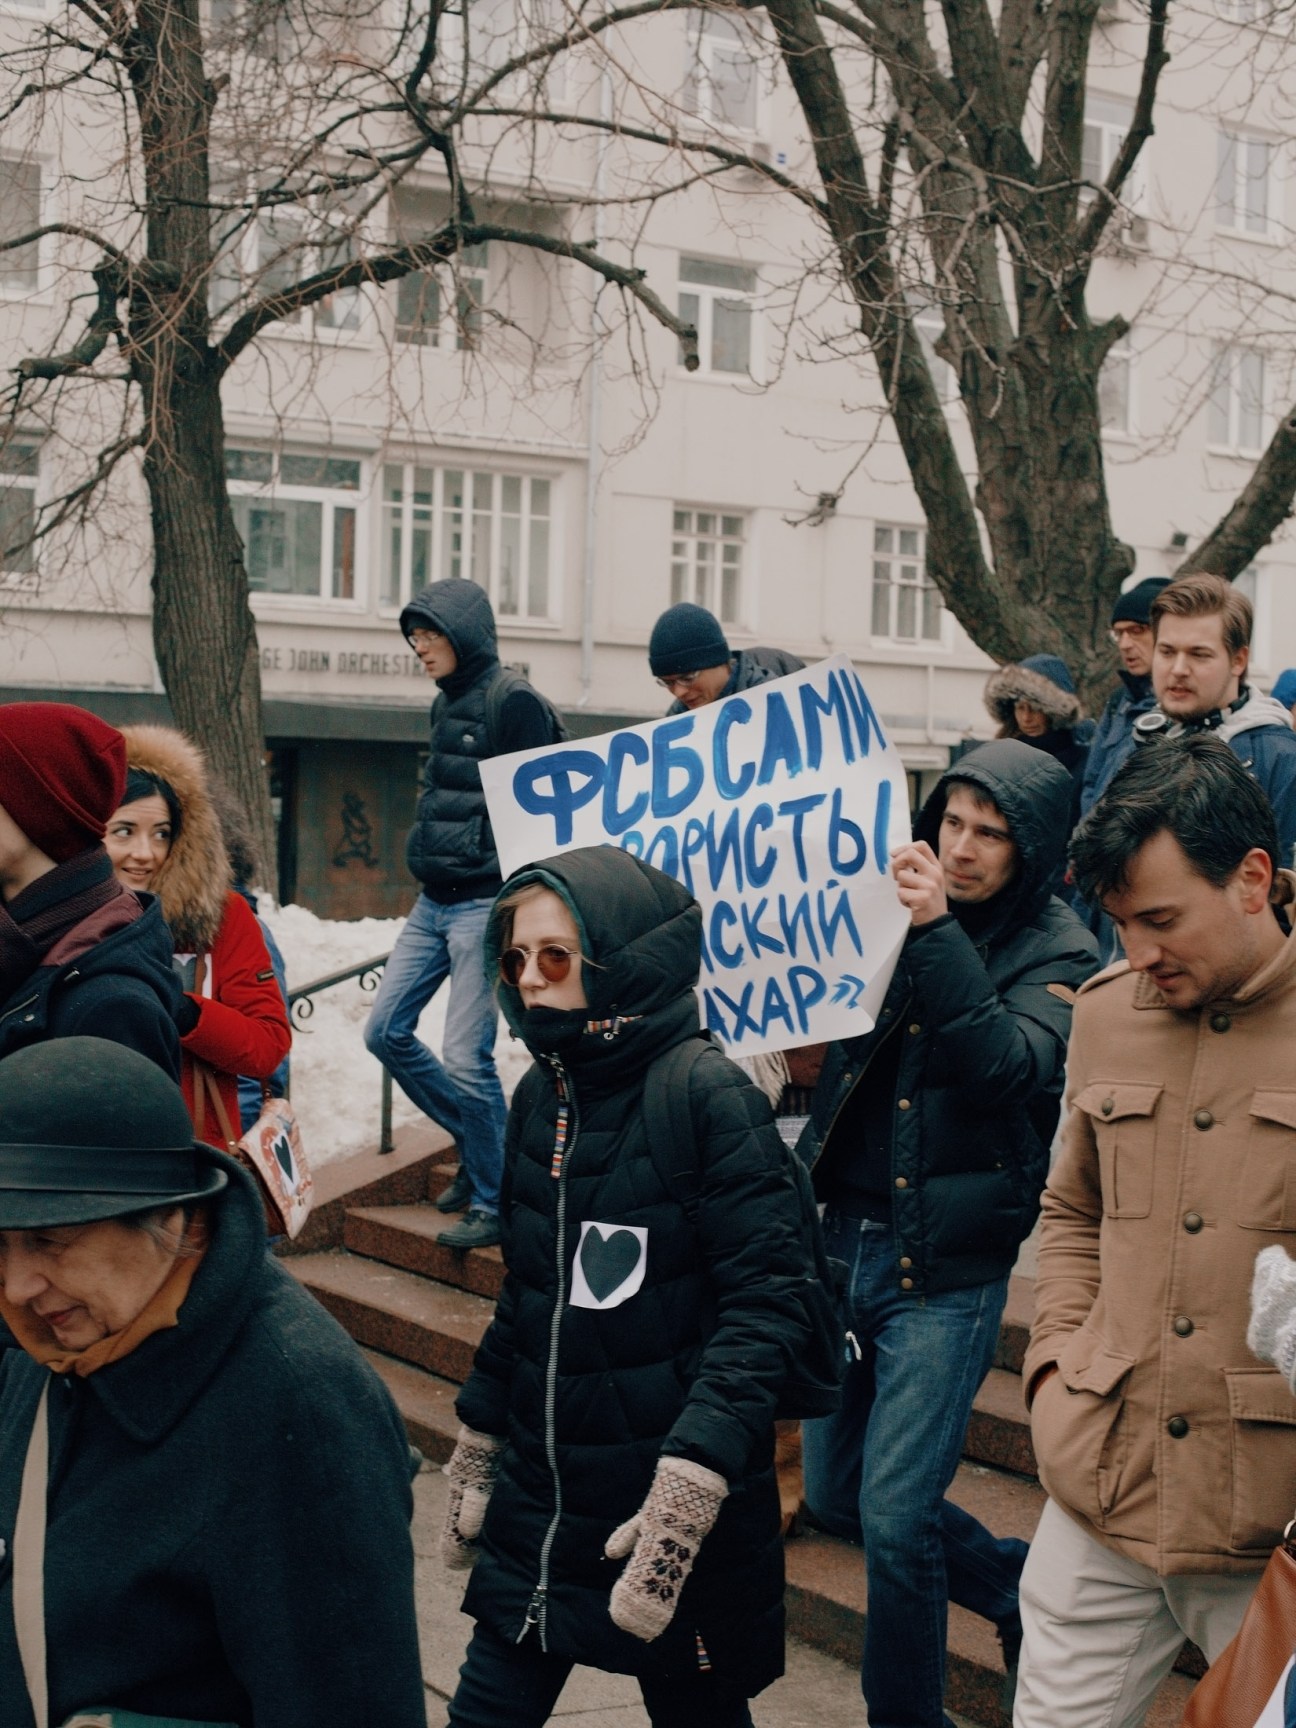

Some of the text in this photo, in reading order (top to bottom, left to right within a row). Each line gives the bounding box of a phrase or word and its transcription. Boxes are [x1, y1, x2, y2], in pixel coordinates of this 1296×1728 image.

[261, 648, 283, 671] GE
[289, 648, 331, 672] JOHN
[513, 668, 887, 846] ФСБ САМИ
[600, 780, 892, 898] ОРИСТЫ
[703, 965, 866, 1045] АХАР»
